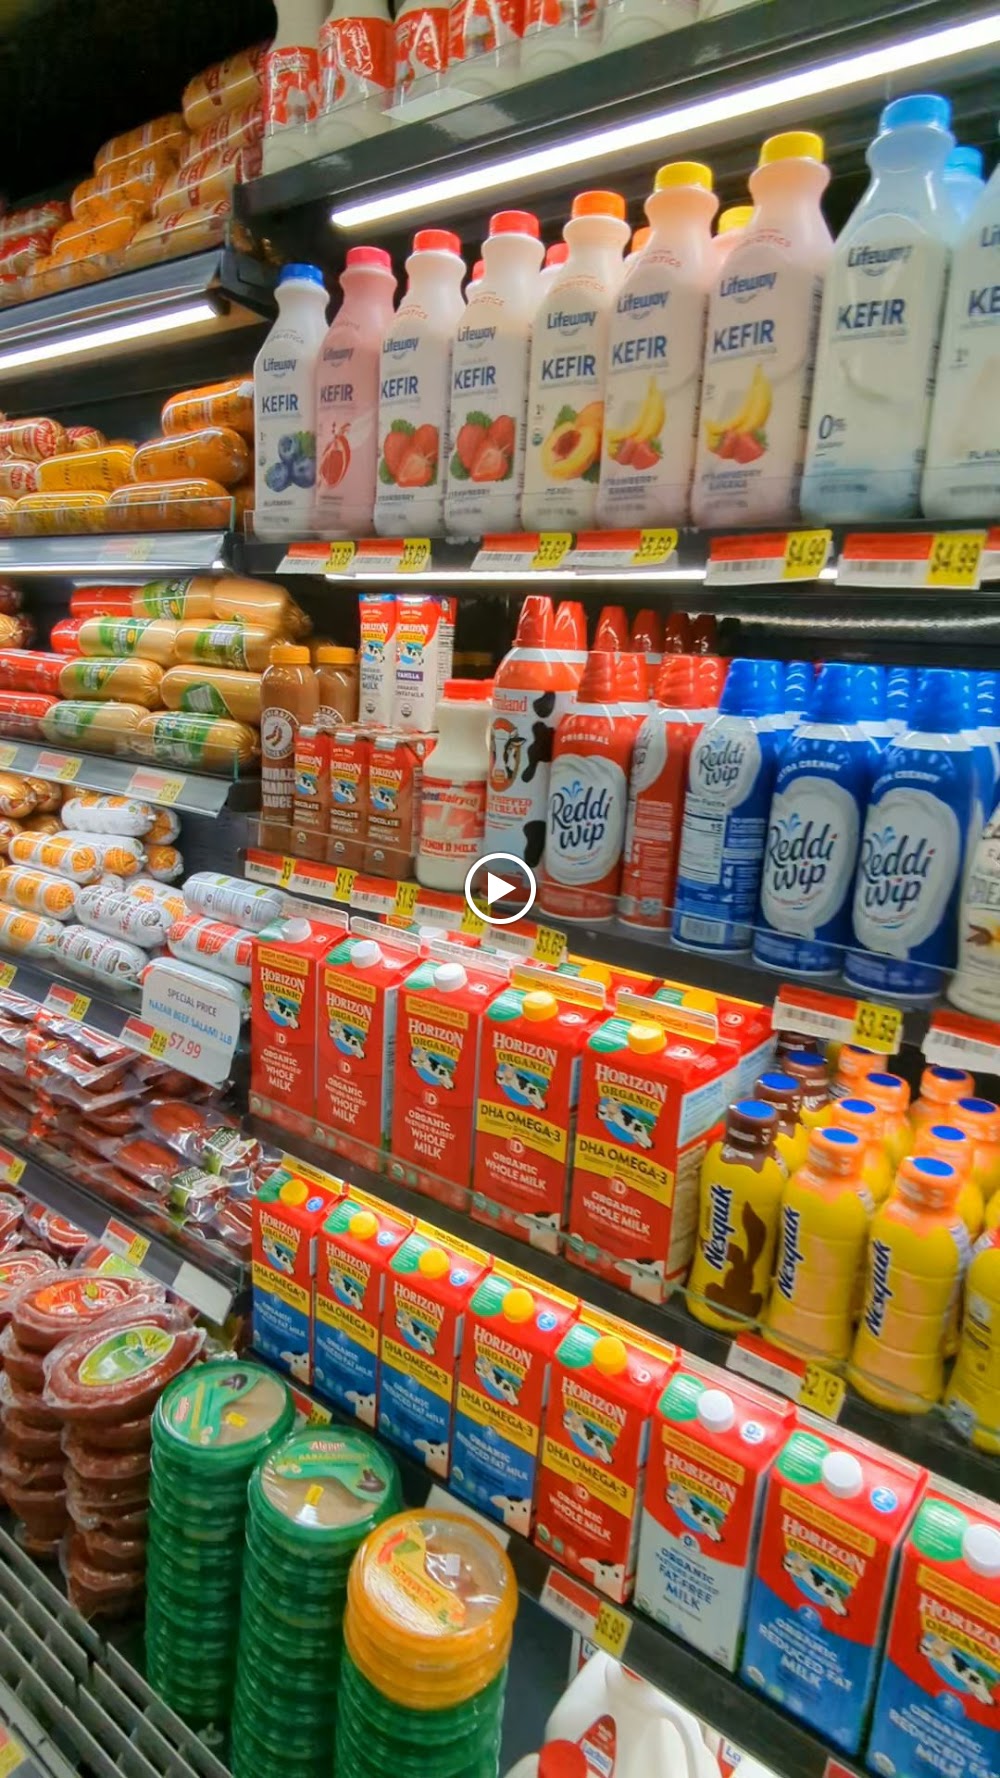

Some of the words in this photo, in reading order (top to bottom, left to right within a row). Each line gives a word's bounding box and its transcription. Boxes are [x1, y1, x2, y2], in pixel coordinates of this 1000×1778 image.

[847, 245, 914, 269] Lifeway
[720, 272, 777, 298] Lifeway
[616, 290, 670, 313] Lifeway
[837, 299, 905, 329] KEFIR
[457, 325, 496, 342] Lifeway
[547, 311, 596, 329] Lifeway
[383, 337, 420, 353] Lifeway
[612, 335, 667, 366] KEFIR
[714, 320, 775, 354] KEFIR
[263, 358, 296, 373] Lifeway
[454, 366, 496, 390] KEFIR
[542, 355, 596, 380] KEFIR
[320, 384, 354, 402] KEFIR
[381, 376, 418, 399] KEFIR
[262, 394, 298, 413] KEFIR
[786, 538, 826, 568] $4.99
[698, 739, 745, 772] Reddi
[704, 764, 739, 788] wip
[368, 816, 399, 826] HOCOLATE
[551, 786, 614, 835] Reddi
[560, 822, 604, 851] wip
[766, 821, 838, 872] Reddi
[861, 835, 935, 884] Reddi
[773, 861, 826, 894] wip
[865, 878, 921, 912] wip
[260, 967, 305, 993] HORIZON
[265, 983, 300, 1001] ORGANIC
[167, 988, 195, 1008] SPECIAL
[196, 1001, 217, 1017] PRICE
[326, 991, 372, 1022] HORIZON
[331, 1009, 367, 1031] ORGANIC
[408, 1018, 464, 1049] HORIZON
[168, 1031, 202, 1059] $7.99
[263, 1048, 298, 1066] ORGANIC
[413, 1037, 457, 1057] ORGANIC
[493, 1031, 558, 1067] HORIZON
[265, 1065, 294, 1082] WHOLE
[498, 1052, 550, 1074] ORGANIC
[269, 1076, 291, 1092] MILK
[327, 1077, 363, 1098] ORGANIC
[595, 1062, 668, 1102] HORIZON
[330, 1095, 359, 1114] WHOLE
[429, 1094, 438, 1106] D
[600, 1086, 658, 1111] ORGANIC
[332, 1107, 356, 1125] MILK
[408, 1109, 451, 1131] ORGANIC
[480, 1104, 504, 1120] DHA
[506, 1110, 561, 1143] OMEGA-3
[410, 1128, 446, 1149] WHOLE
[414, 1142, 442, 1160] MILK
[485, 1157, 518, 1180] WHOLE
[519, 1172, 546, 1190] MILK
[493, 1151, 538, 1176] ORGANIC
[579, 1140, 606, 1157] DHA
[607, 1149, 668, 1185] OMEGA-3
[583, 1197, 620, 1223] WHOLE
[621, 1214, 650, 1236] MILK
[591, 1191, 642, 1217] ORGANIC
[259, 1209, 301, 1242] HORIZON
[262, 1225, 298, 1248] ORGANIC
[702, 1184, 735, 1271] Nesquik
[326, 1240, 372, 1278] HORIZON
[777, 1205, 804, 1300] Nesquik
[254, 1265, 267, 1277] DHA
[269, 1273, 306, 1300] OMEGA-3
[329, 1256, 368, 1283] ORGANIC
[394, 1281, 445, 1322] HORIZON
[864, 1239, 893, 1338] Nesquik
[318, 1297, 334, 1311] DHA
[335, 1308, 375, 1339] OMEGA-3
[397, 1299, 439, 1327] ORGANIC
[289, 1326, 305, 1337] MILK
[384, 1340, 403, 1356] DHA
[404, 1351, 449, 1385] OMEGA-3
[473, 1325, 533, 1370] HORIZON
[477, 1345, 524, 1375] ORGANIC
[355, 1363, 373, 1377] MILK
[393, 1382, 430, 1409] ORGANIC
[561, 1376, 627, 1427] HORIZON
[426, 1410, 445, 1426] MILK
[461, 1388, 481, 1406] DHA
[483, 1401, 534, 1437] OMEGA-3
[566, 1398, 618, 1431] ORGANIC
[469, 1434, 511, 1463] ORGANIC
[506, 1464, 528, 1481] MILK
[546, 1441, 571, 1463] DHA
[572, 1456, 628, 1499] OMEGA-3
[663, 1449, 737, 1503] HORIZON
[670, 1470, 729, 1509] ORGANIC
[549, 1494, 586, 1527] WHOLE
[586, 1516, 612, 1541] MILK
[557, 1490, 603, 1524] ORGANIC
[781, 1514, 867, 1577] HORIZON
[788, 1540, 851, 1581] ORGANIC
[661, 1548, 715, 1585] ORGANIC
[659, 1563, 712, 1605] FAT-FREE
[665, 1583, 701, 1611] MILK
[775, 1618, 838, 1662] ORGANIC
[759, 1623, 825, 1676] REDUCED
[825, 1669, 853, 1691] FAT
[780, 1654, 822, 1690] MILK
[889, 1708, 966, 1766] REDUCED
[909, 1703, 983, 1753] ORGANIC
